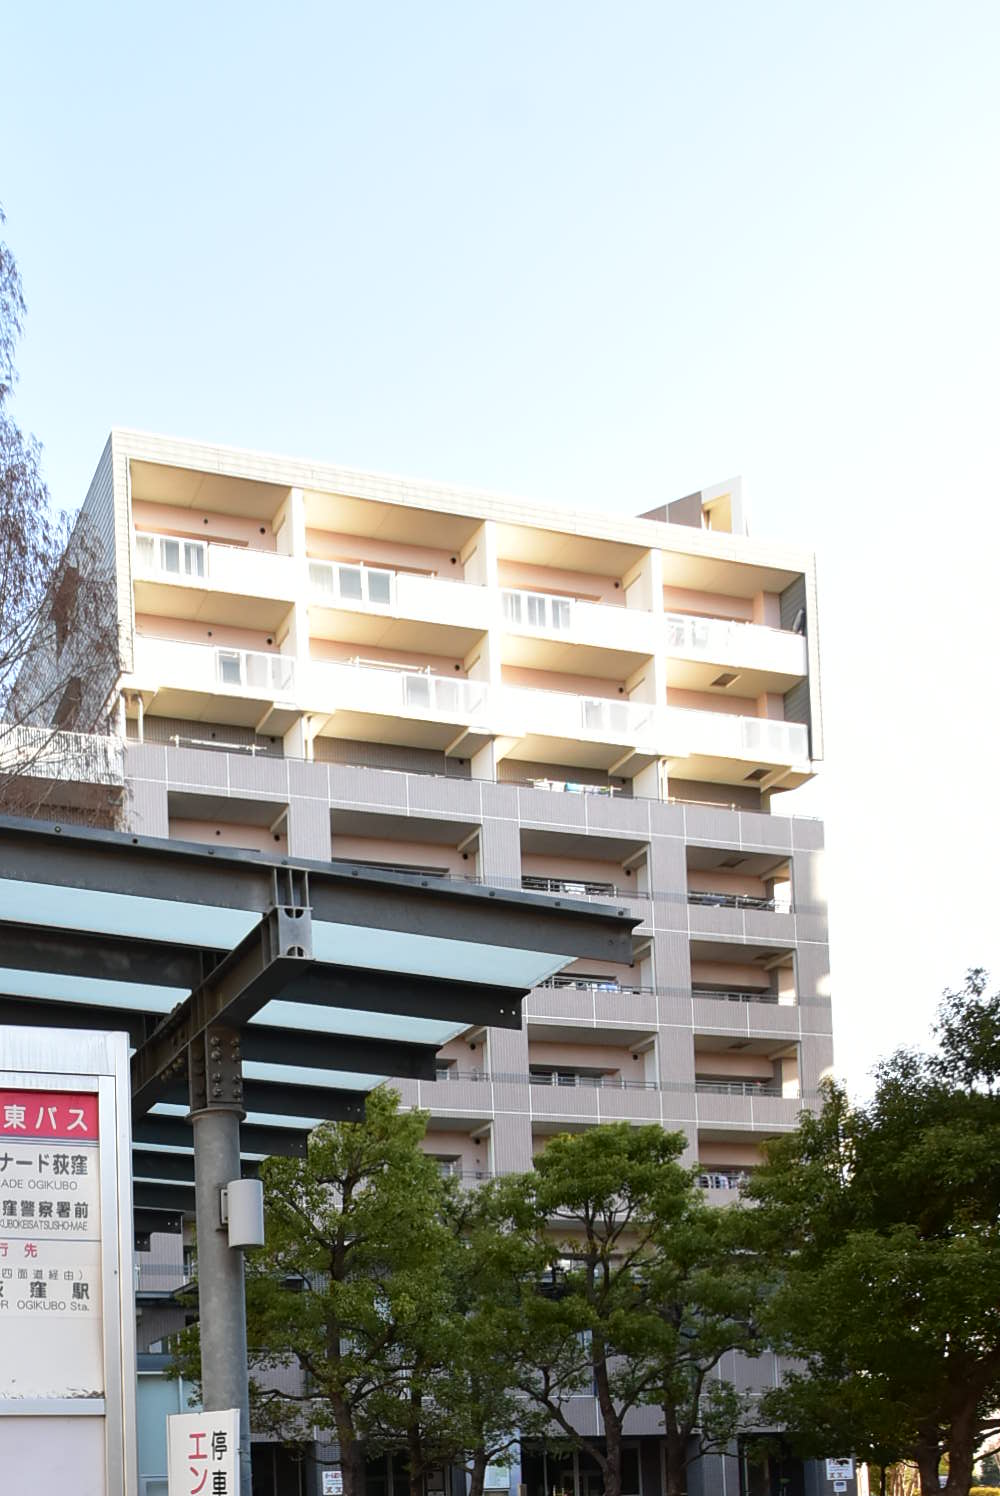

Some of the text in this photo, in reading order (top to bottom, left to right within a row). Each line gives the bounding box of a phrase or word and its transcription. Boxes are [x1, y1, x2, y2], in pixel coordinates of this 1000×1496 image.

[28, 1179, 78, 1191] OGIKUBO
[16, 1300, 67, 1311] OGIKUBO
[70, 1301, 90, 1311] Sta.
